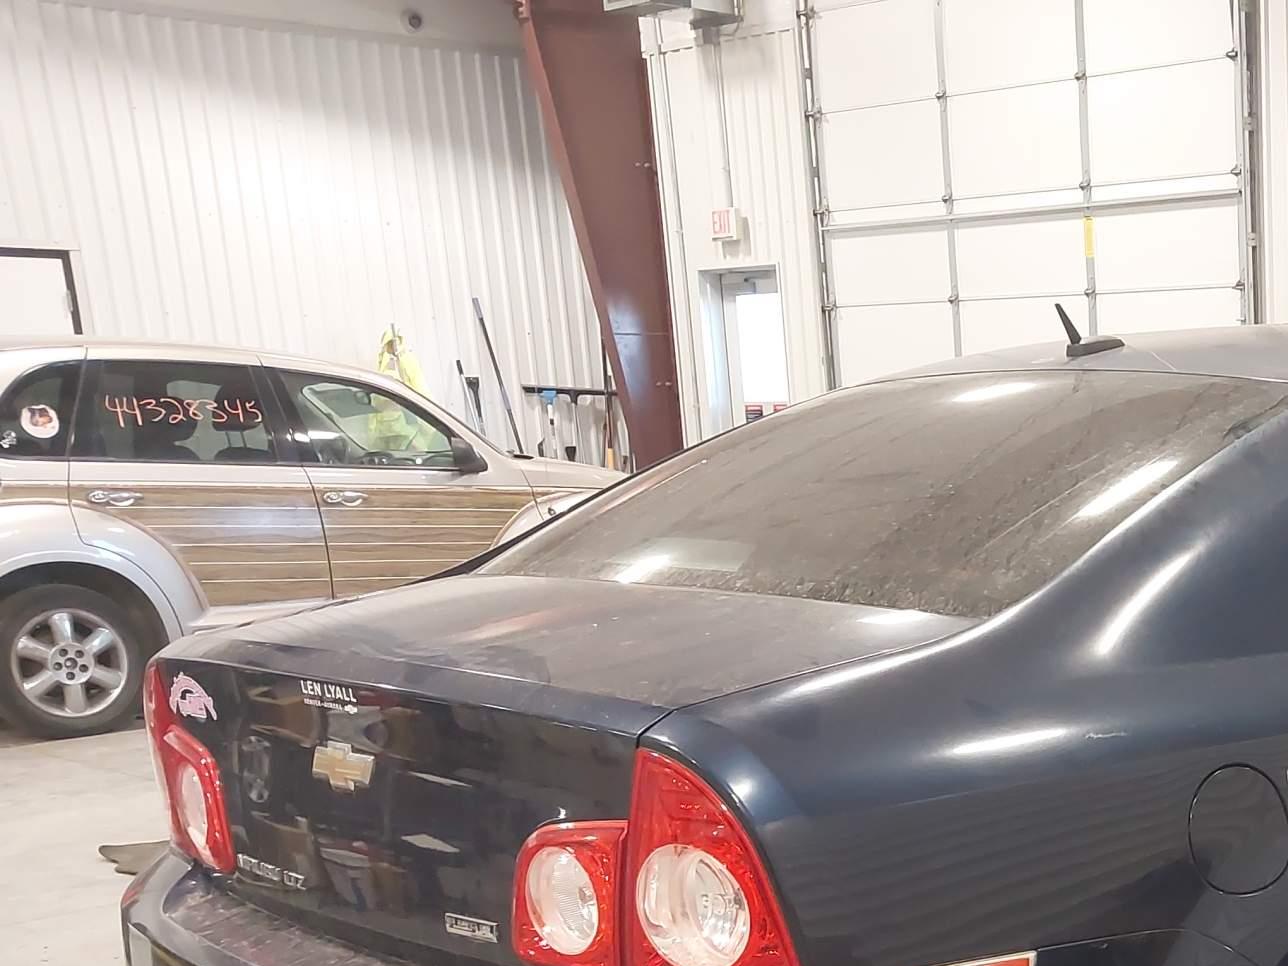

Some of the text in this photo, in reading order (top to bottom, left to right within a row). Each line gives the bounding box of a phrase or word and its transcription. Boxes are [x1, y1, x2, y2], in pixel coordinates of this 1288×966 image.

[711, 209, 731, 234] EXIT
[300, 679, 357, 703] LEN LYALL
